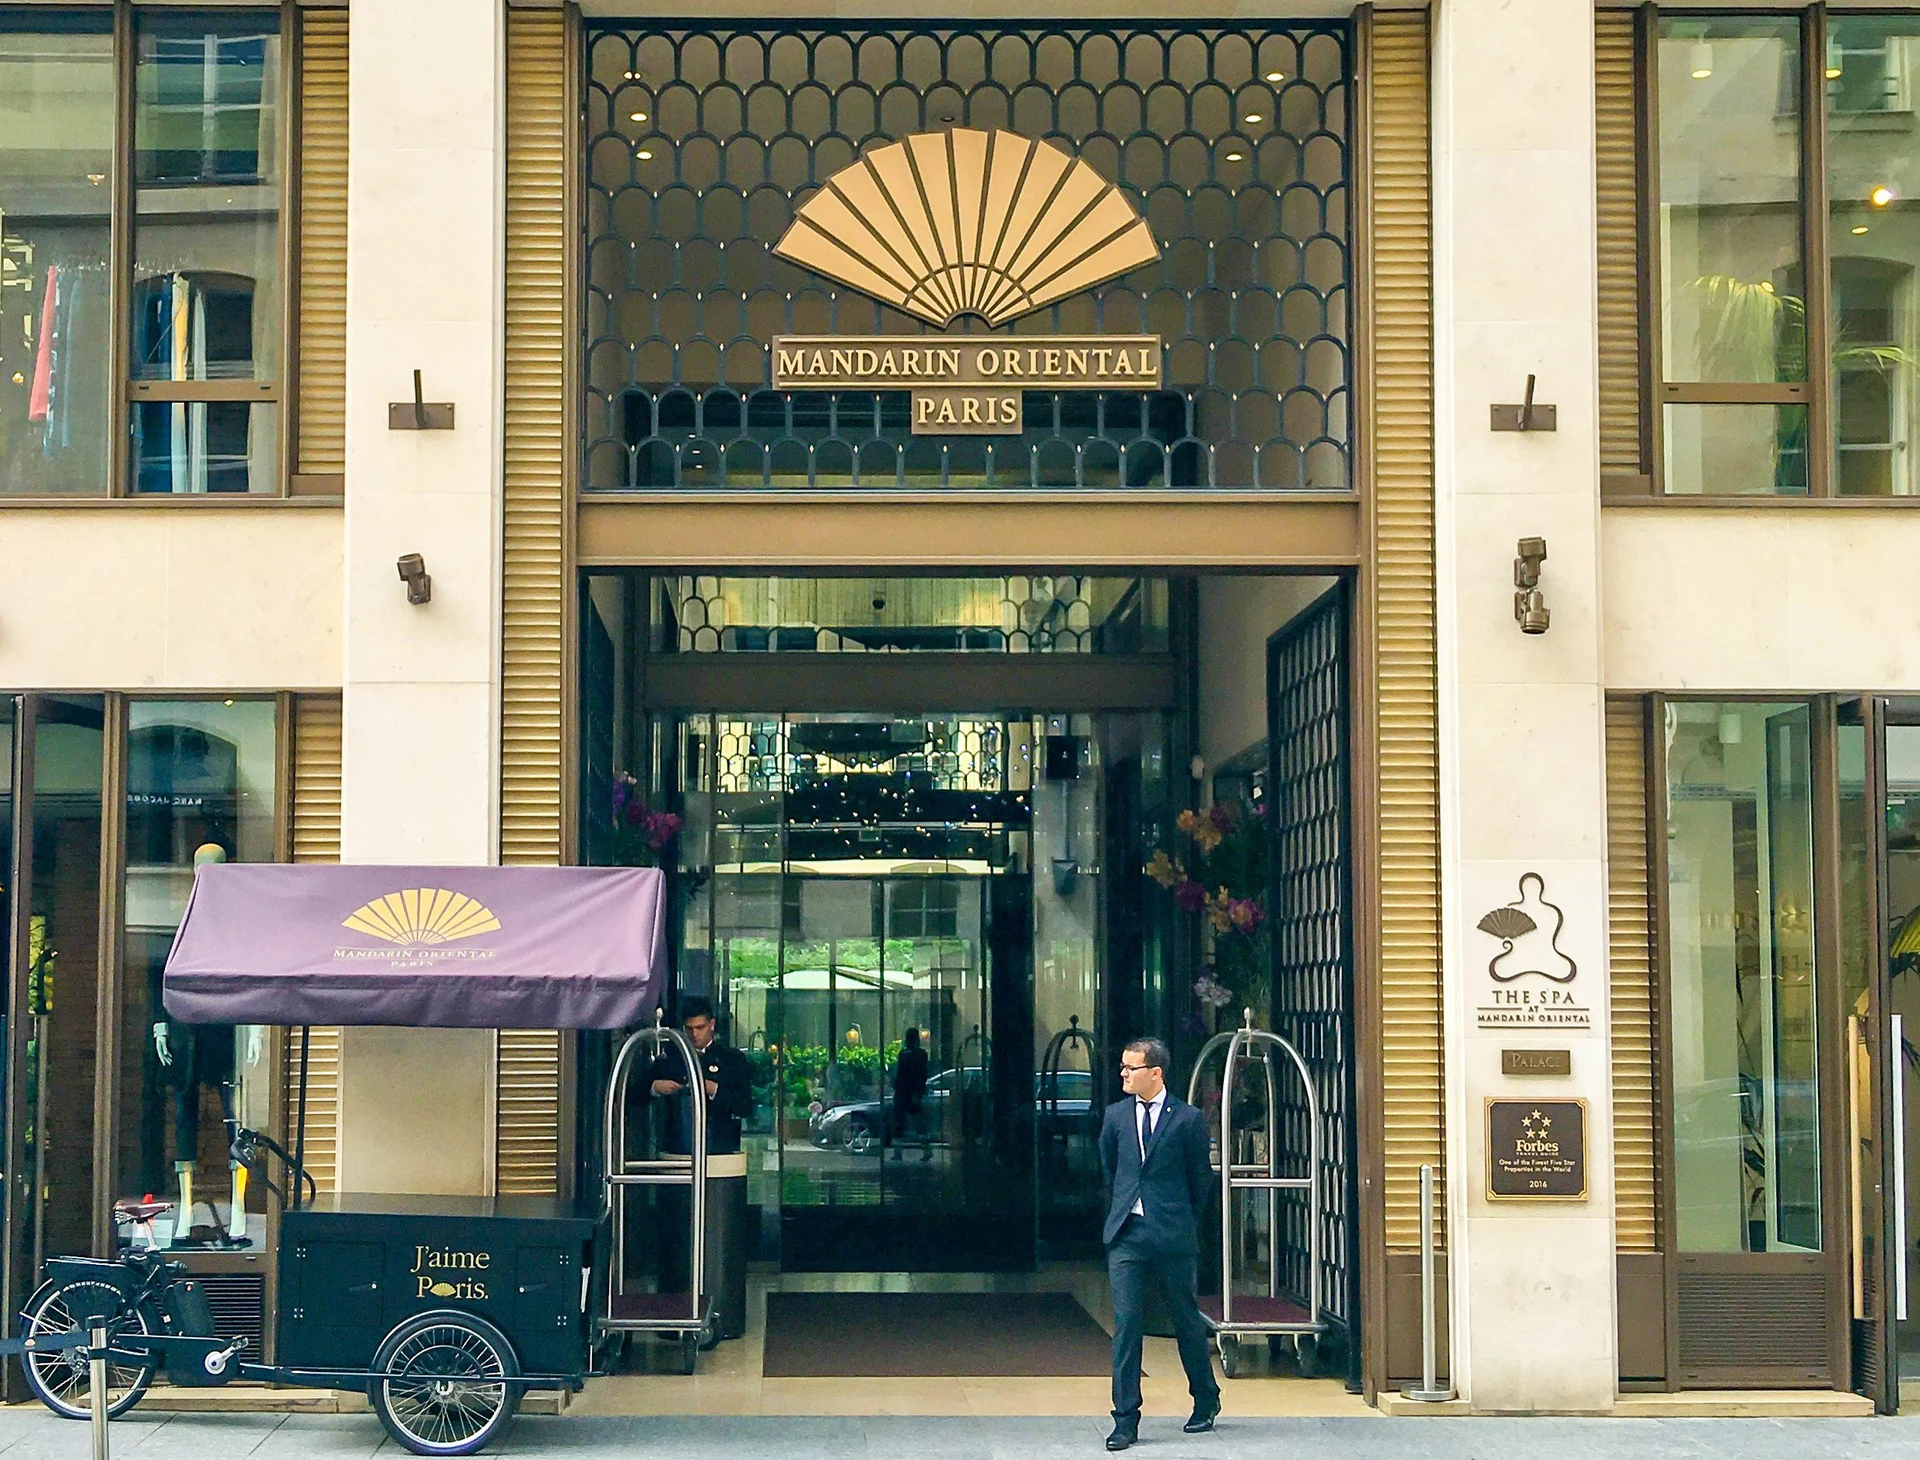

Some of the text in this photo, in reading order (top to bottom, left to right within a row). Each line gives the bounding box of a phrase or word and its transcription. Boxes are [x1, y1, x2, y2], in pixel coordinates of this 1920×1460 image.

[777, 349, 1158, 377] MANDARIN ORIENTAL
[917, 397, 1018, 425] PARIS
[333, 949, 497, 958] MANDARIN ORIENTAL
[1492, 990, 1575, 1004] THE SPA
[1528, 1005, 1539, 1013] AT
[1477, 1014, 1590, 1023] MANDARIN ORIENTAL
[1515, 1139, 1559, 1152] Forbes
[1529, 1180, 1547, 1188] 2016
